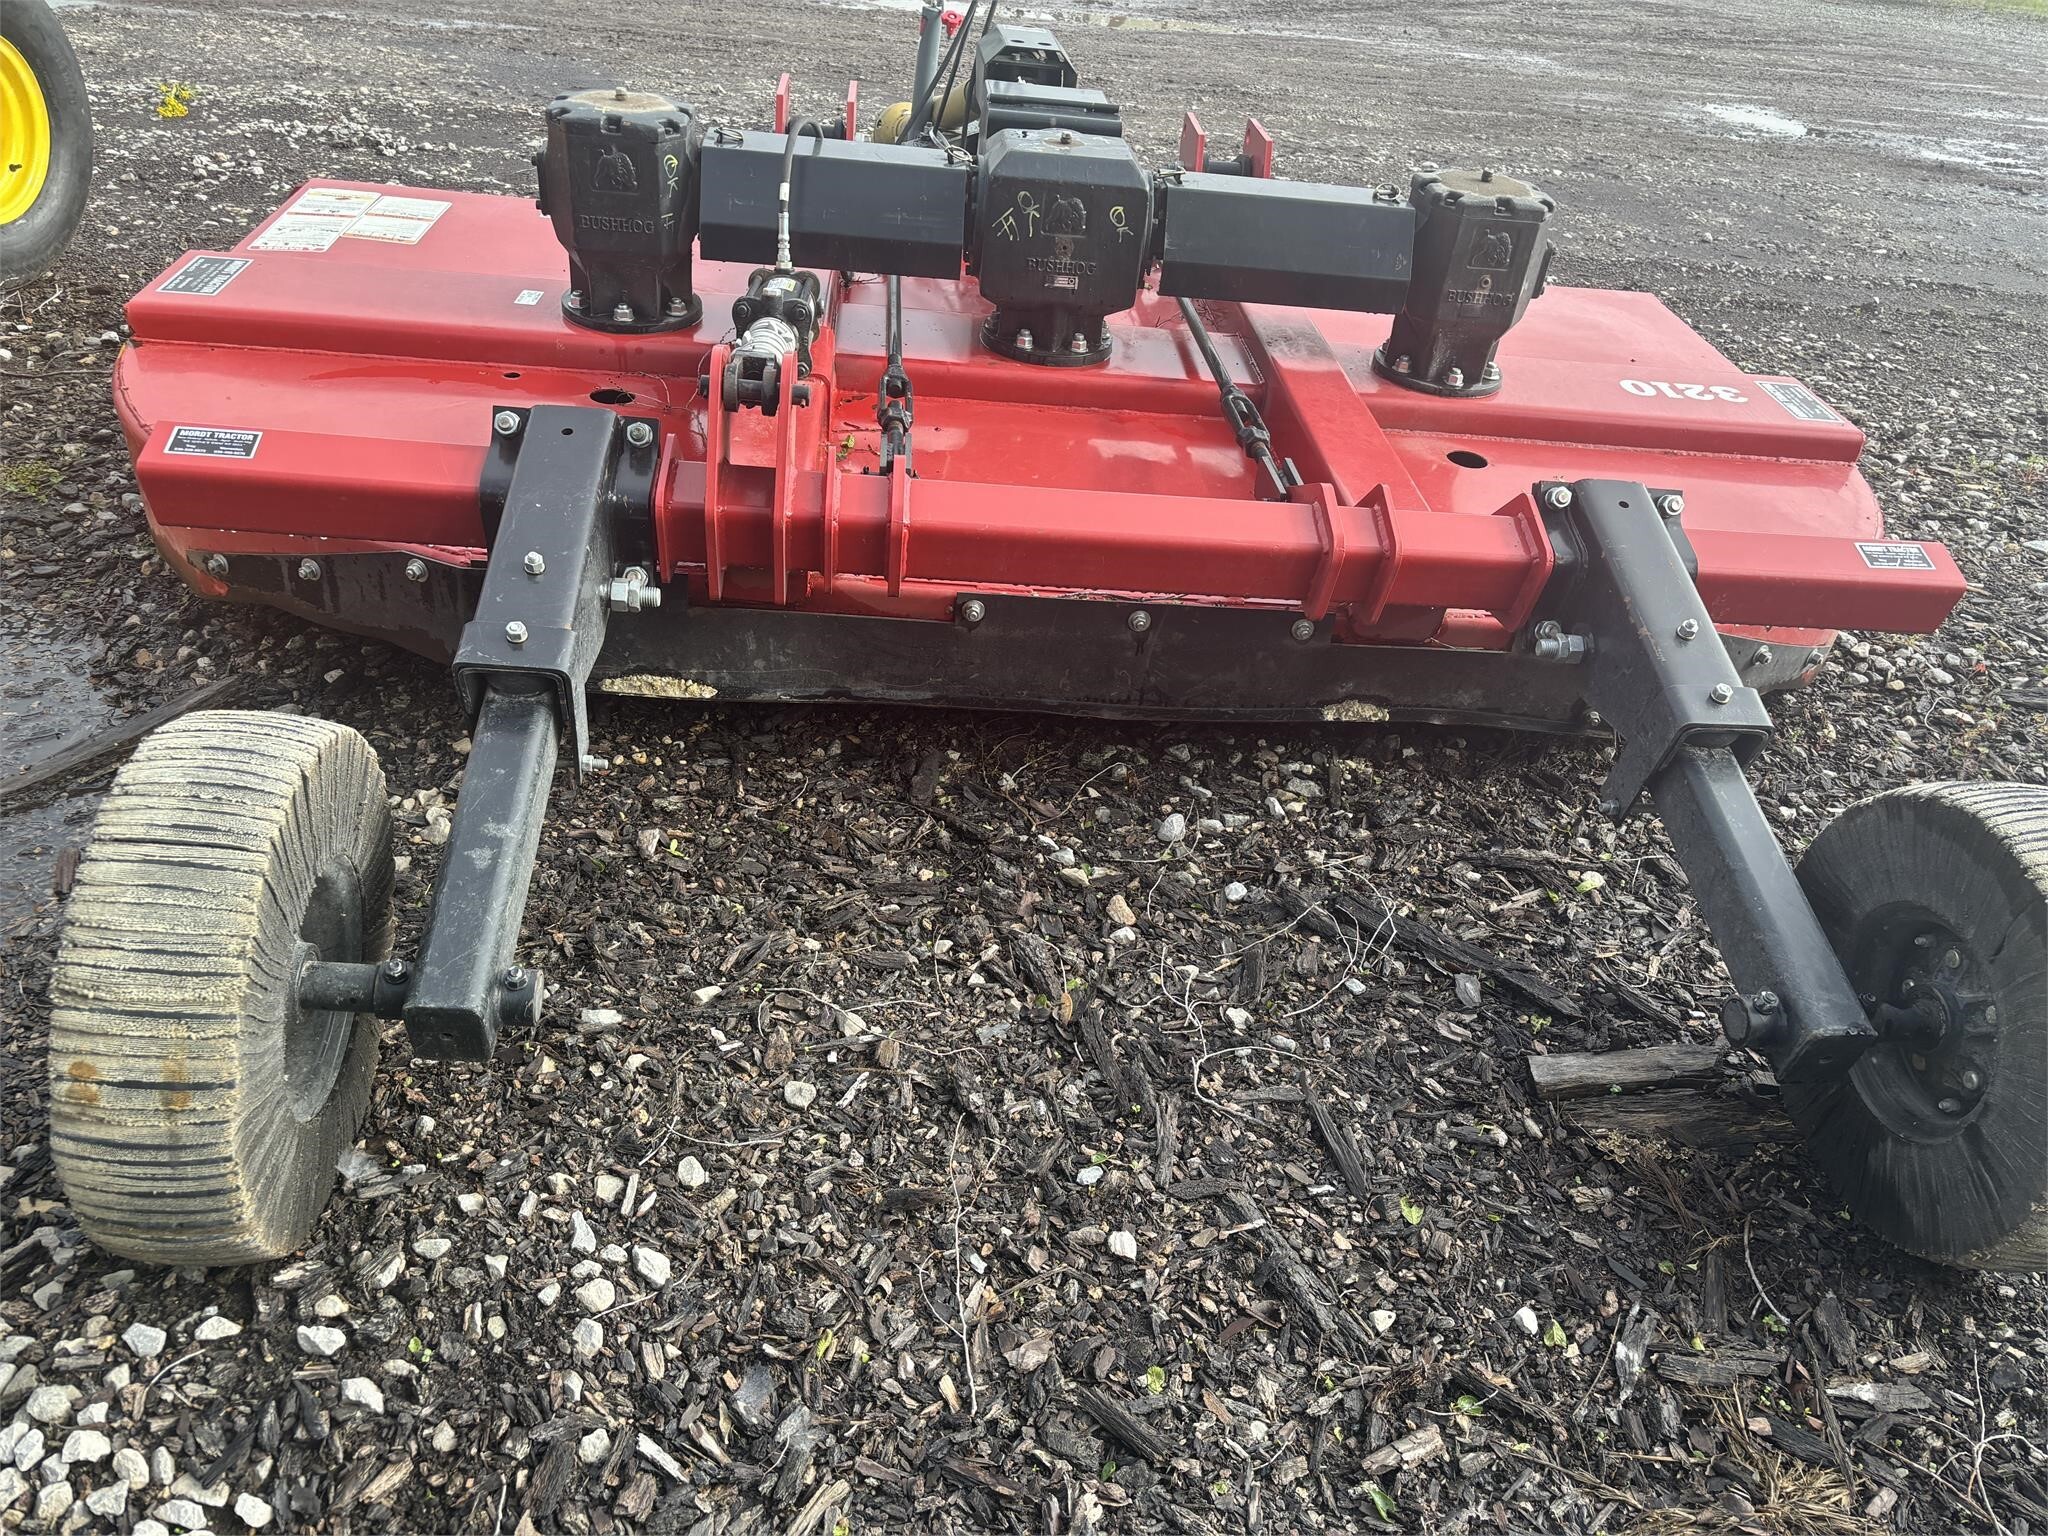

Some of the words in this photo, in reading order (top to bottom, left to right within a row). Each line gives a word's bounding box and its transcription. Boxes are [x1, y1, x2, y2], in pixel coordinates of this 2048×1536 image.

[579, 214, 655, 234] BUSHHOG
[1027, 257, 1097, 275] BUSHHOG
[1448, 289, 1515, 306] BUSHHOG
[1619, 378, 1749, 404] 3210
[179, 429, 212, 438] MORDT
[214, 431, 254, 441] TRACTOR
